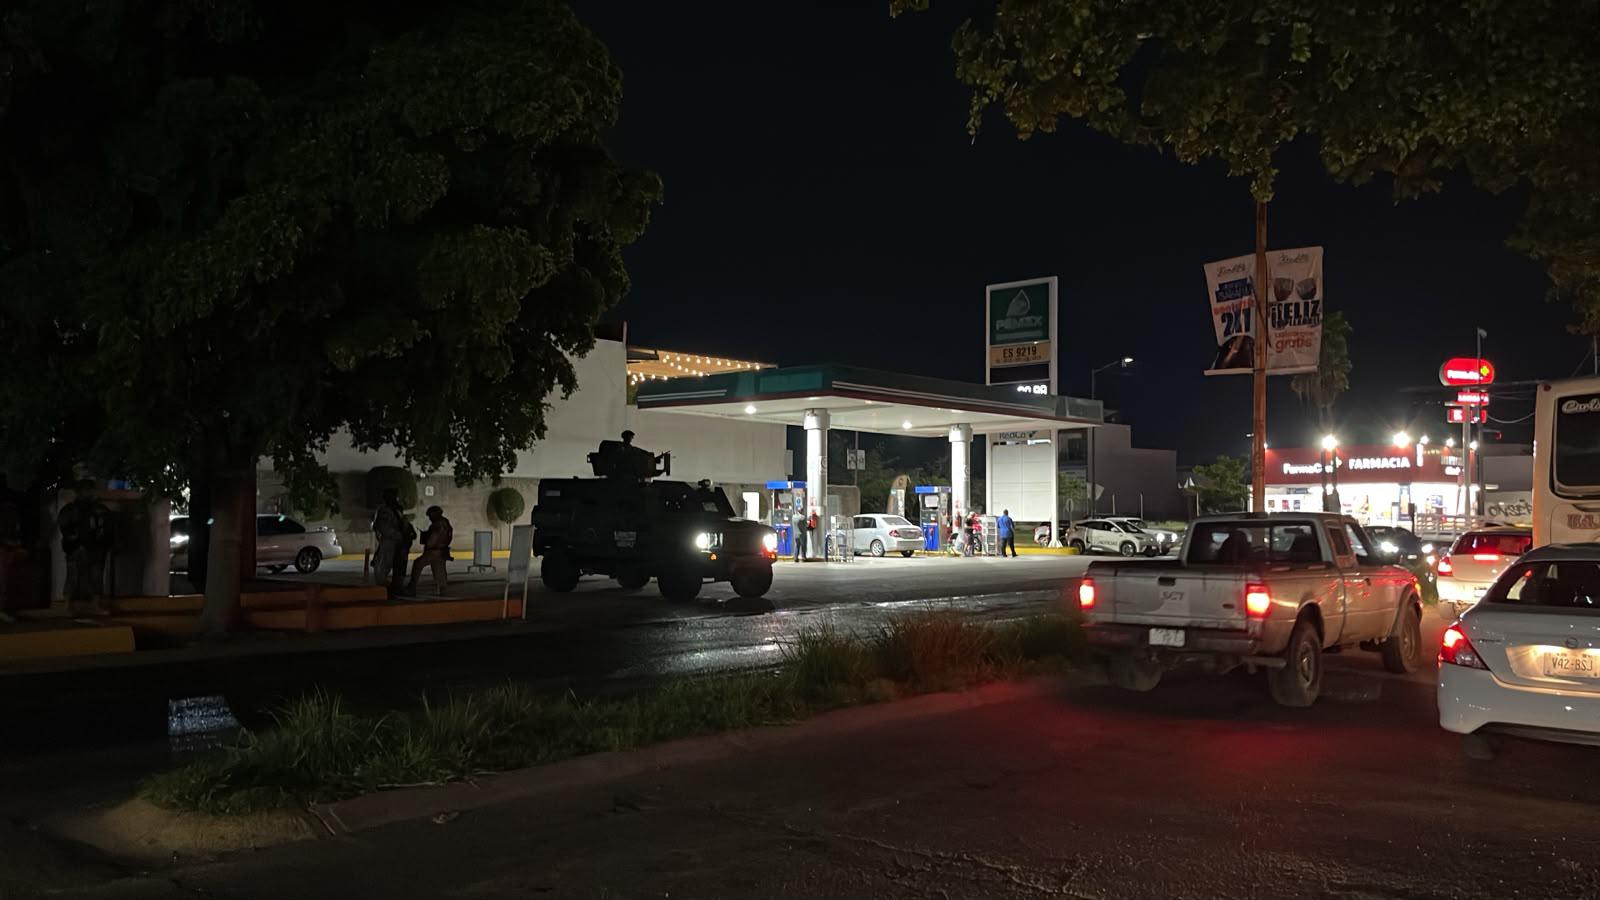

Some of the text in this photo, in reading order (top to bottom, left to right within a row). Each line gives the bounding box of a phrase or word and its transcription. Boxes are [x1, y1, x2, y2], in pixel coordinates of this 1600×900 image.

[1003, 346, 1037, 359] ES 9219
[1349, 457, 1411, 470] FARMACIA
[1552, 657, 1593, 671] V42-BSJ
